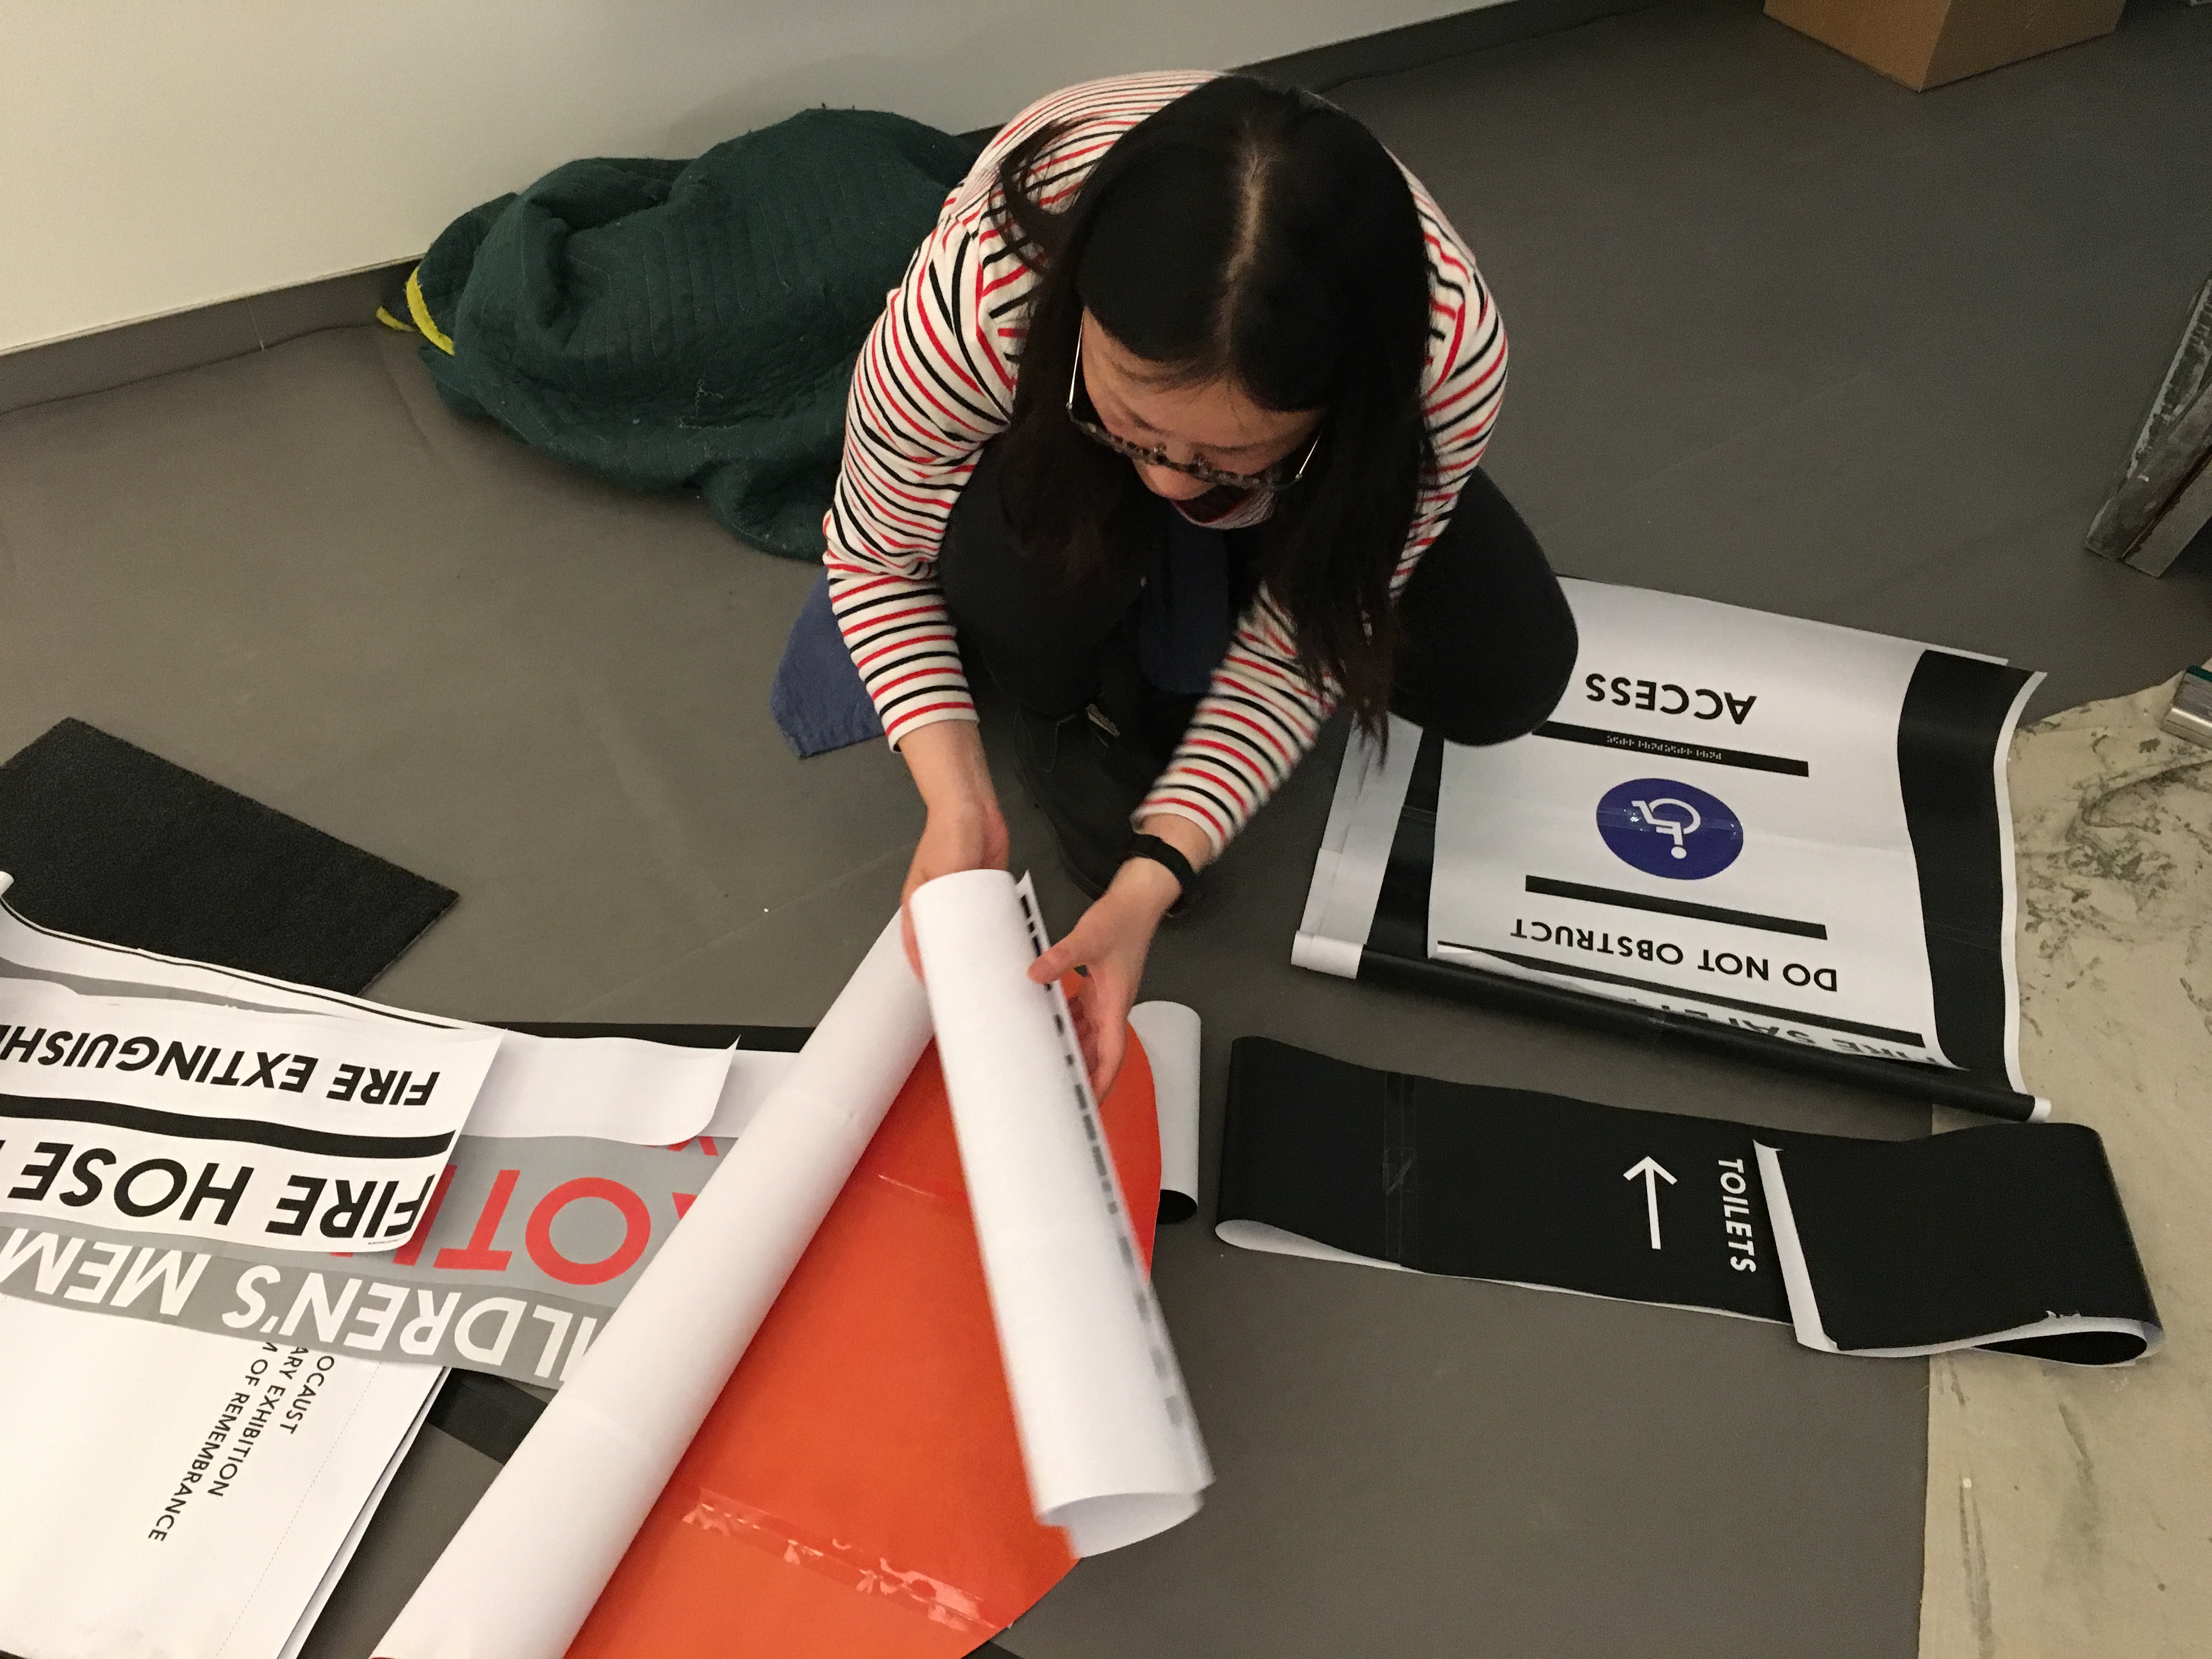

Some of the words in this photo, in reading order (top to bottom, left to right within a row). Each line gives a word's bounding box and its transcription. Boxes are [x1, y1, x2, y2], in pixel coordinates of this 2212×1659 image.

[1584, 673, 1757, 725] ACCESS
[1510, 918, 1683, 965] OBSTRUCT
[1697, 949, 1769, 981] NOT
[1782, 962, 1838, 992] DO
[0, 1024, 319, 1093] EXTINGUISH
[327, 1063, 441, 1107] FIRE
[8, 1141, 255, 1226] HOSE
[266, 1173, 436, 1242] FIRE
[1718, 1158, 1757, 1273] TOILETS
[245, 1359, 268, 1387] OF
[280, 1355, 335, 1434] OCAUST
[148, 1391, 250, 1542] REMEMBRANCE
[207, 1385, 286, 1497] EXHIBITION
